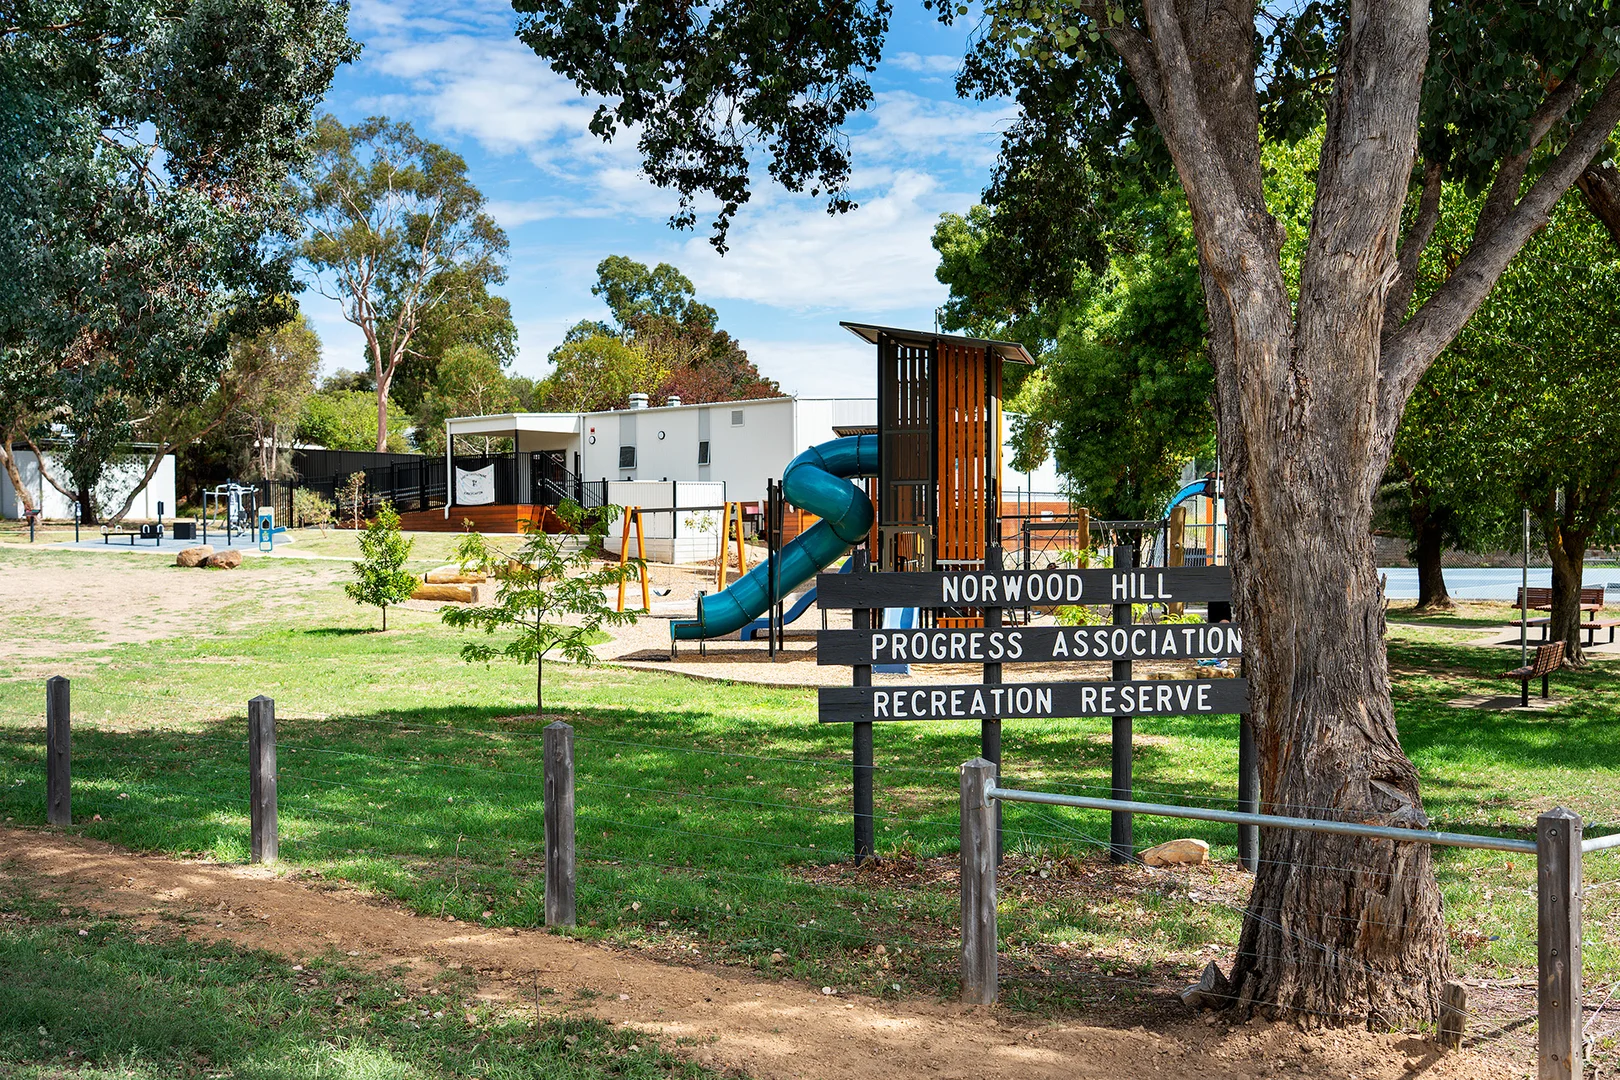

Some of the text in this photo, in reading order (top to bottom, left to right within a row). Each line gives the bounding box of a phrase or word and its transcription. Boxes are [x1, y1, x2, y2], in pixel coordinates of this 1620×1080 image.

[942, 572, 1173, 603] NORWOOD HILL
[872, 626, 1243, 660] PROGRESS ASSOCIATION
[873, 684, 1212, 718] RECREATION RESERVE
